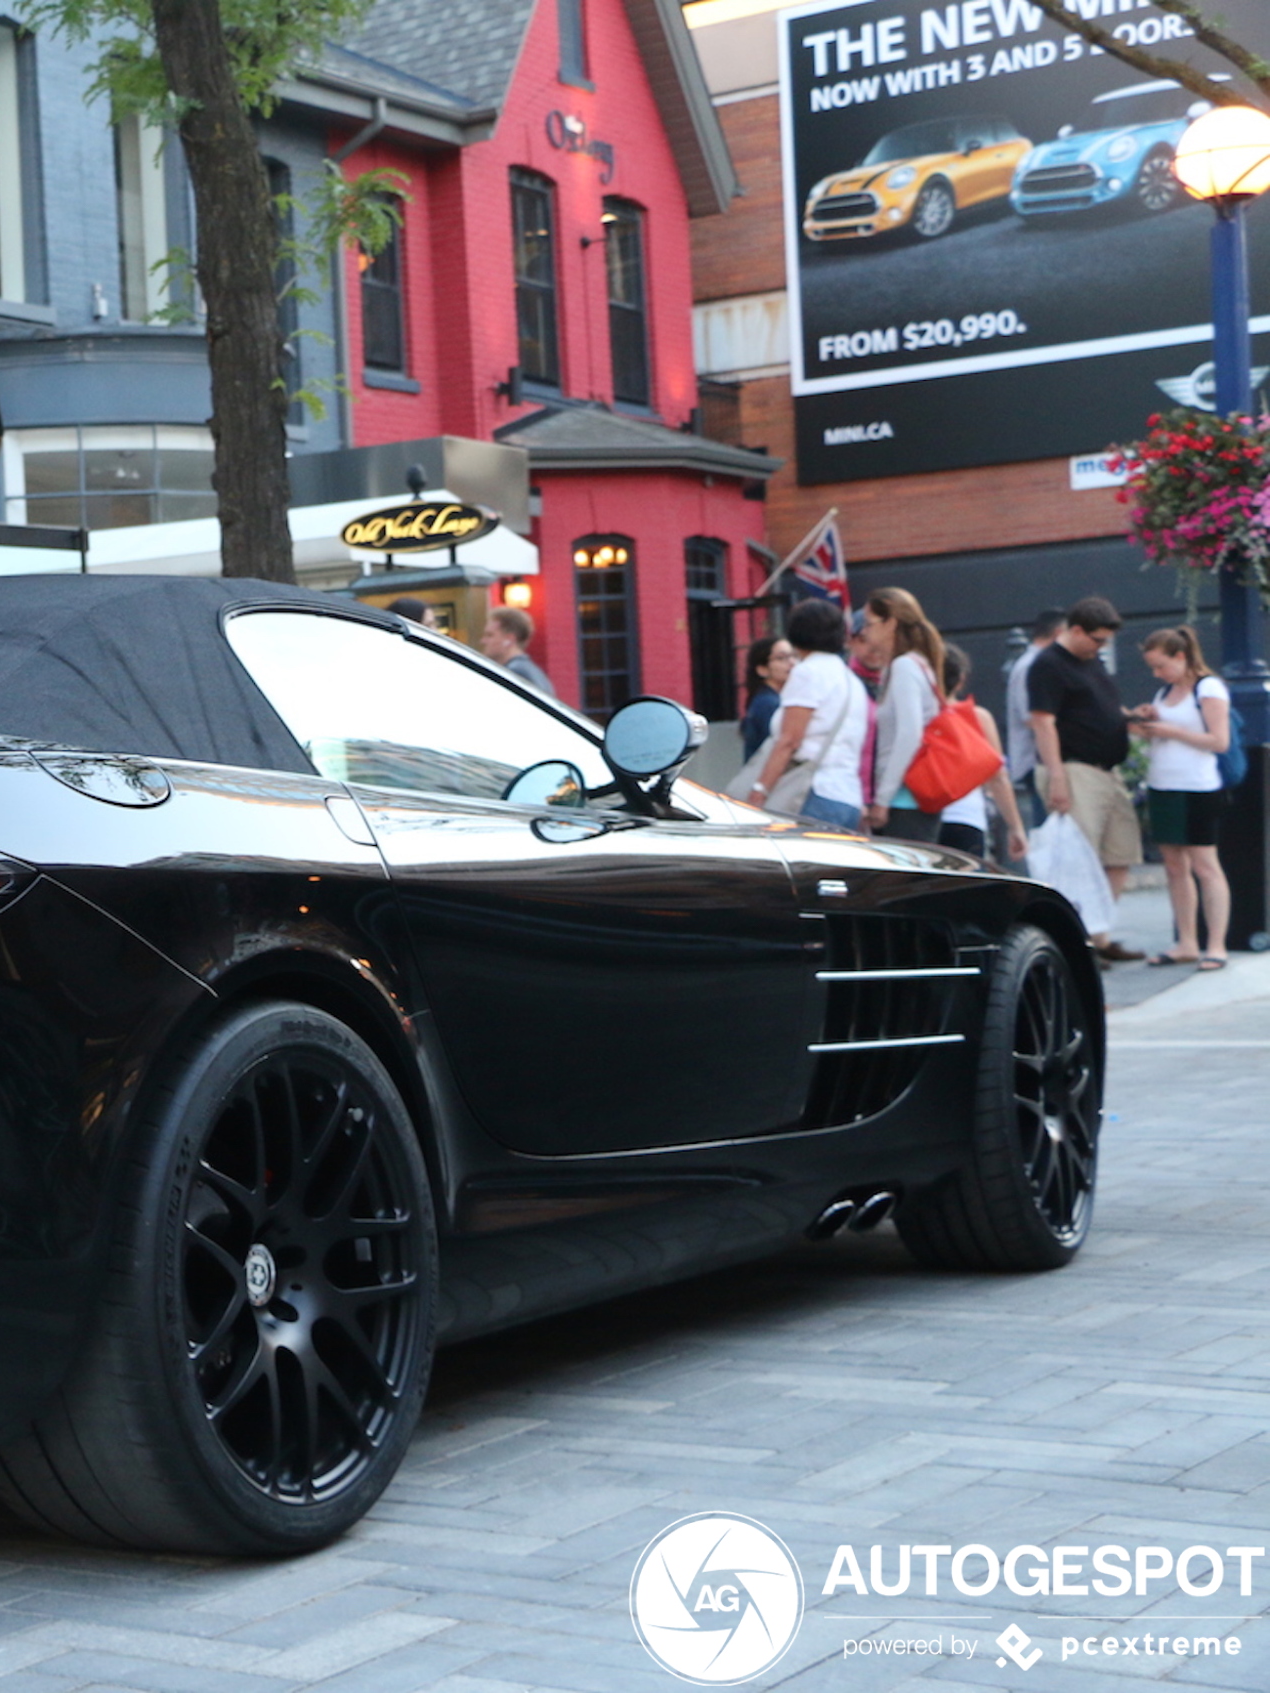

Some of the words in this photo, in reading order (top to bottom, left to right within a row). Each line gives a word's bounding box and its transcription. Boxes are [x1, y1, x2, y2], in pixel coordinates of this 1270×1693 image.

[802, 16, 907, 77] THE
[921, 0, 1043, 54] NEW
[810, 76, 880, 112] NOW
[884, 60, 960, 97] WITH
[966, 53, 987, 81] 3
[990, 40, 1058, 76] AND
[1063, 34, 1083, 62] 5
[819, 327, 898, 361] FROM
[902, 309, 1027, 351] $20,990.
[823, 421, 894, 446] MINI.CA
